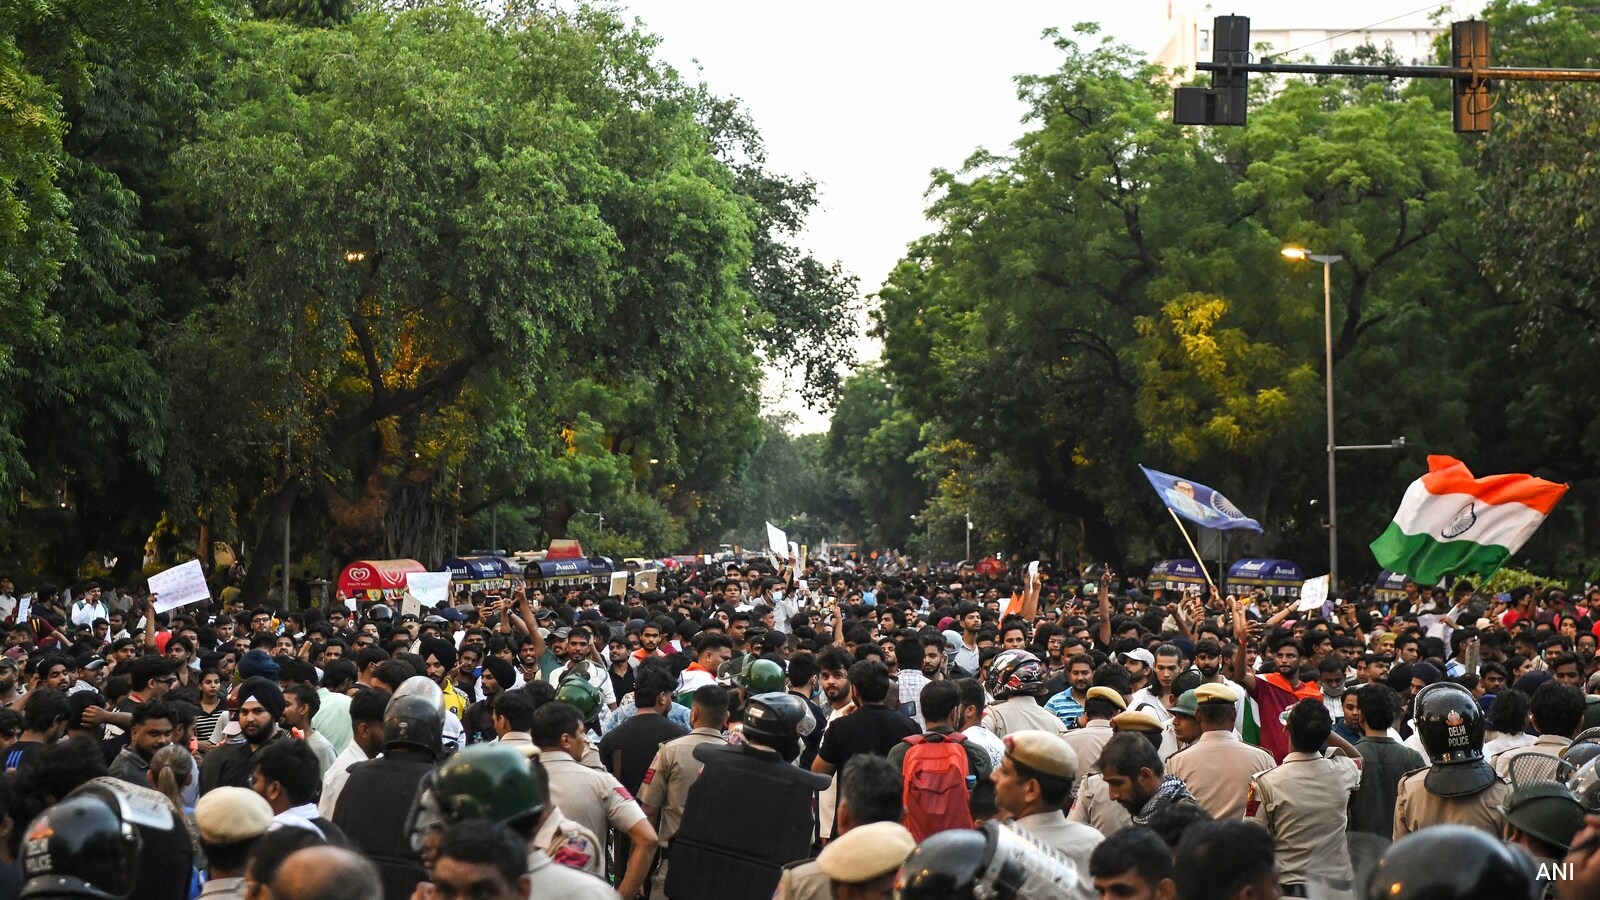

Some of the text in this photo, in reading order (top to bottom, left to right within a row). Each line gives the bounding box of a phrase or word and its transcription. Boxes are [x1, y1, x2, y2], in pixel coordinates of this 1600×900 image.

[446, 566, 467, 574] Amul
[555, 563, 578, 571] Amul
[1448, 725, 1467, 737] DELHI
[1448, 735, 1470, 747] POLICE
